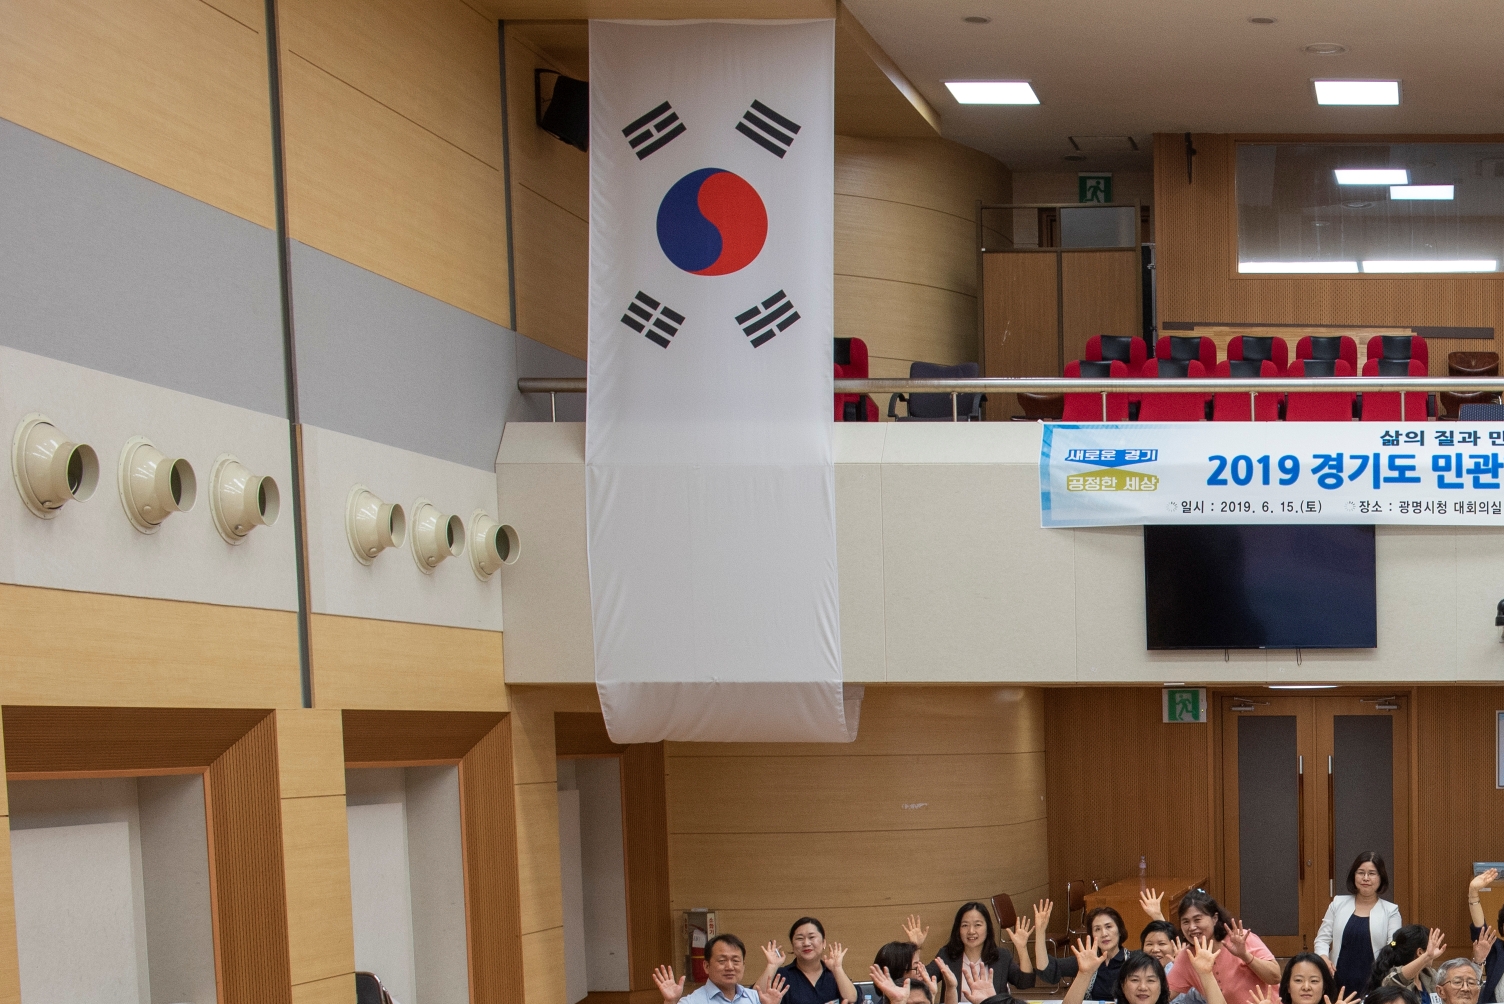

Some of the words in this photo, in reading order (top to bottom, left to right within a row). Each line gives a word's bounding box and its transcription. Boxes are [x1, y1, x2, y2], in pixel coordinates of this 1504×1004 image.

[1379, 430, 1425, 447] 삶의
[1434, 430, 1481, 447] 질과
[1066, 449, 1117, 461] 새로운
[1123, 449, 1157, 461] 경기
[1206, 453, 1301, 487] 2019
[1310, 452, 1422, 491] 경기도
[1067, 476, 1118, 492] 공정한
[1122, 476, 1158, 492] 세상
[1181, 500, 1204, 514] 일시
[1220, 501, 1256, 514] 2019.
[1261, 501, 1274, 514] 6.
[1359, 500, 1383, 514] 장소
[1398, 500, 1447, 515] 광명시청
[1454, 500, 1502, 515] 대회의실
